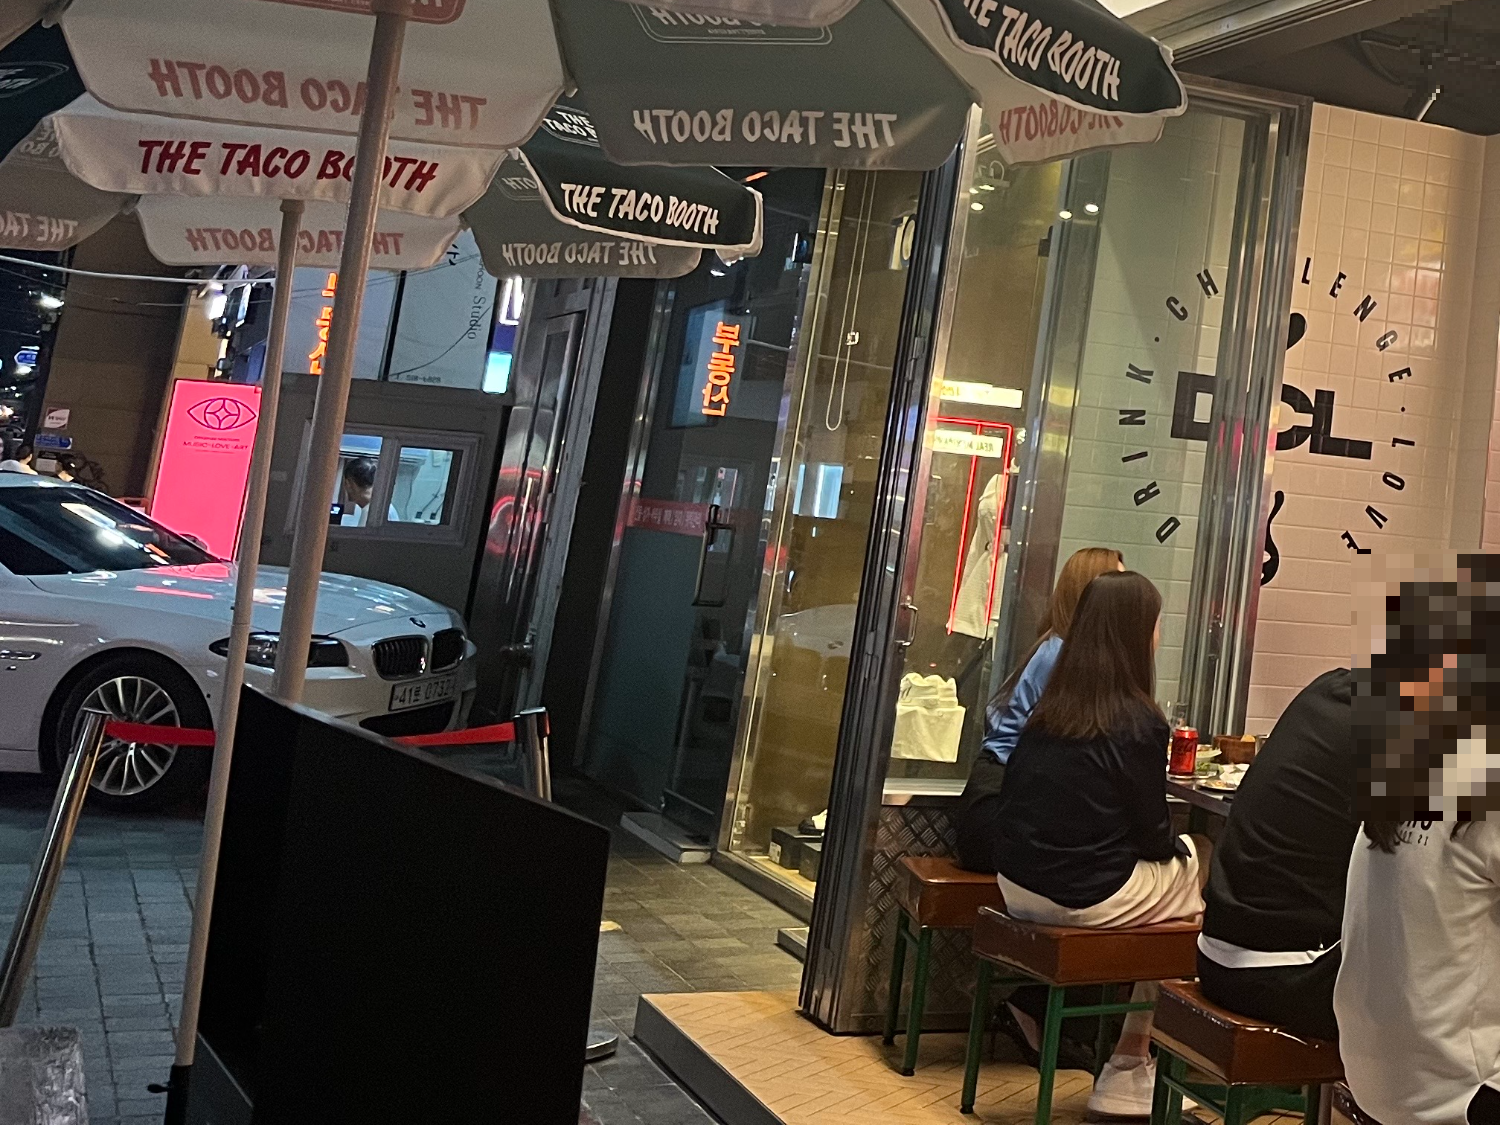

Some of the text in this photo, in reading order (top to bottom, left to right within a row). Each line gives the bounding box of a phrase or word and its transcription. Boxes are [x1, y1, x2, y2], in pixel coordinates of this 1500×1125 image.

[995, 5, 1052, 71] TACO
[1050, 30, 1122, 102] BOOTH
[138, 140, 213, 175] THE
[220, 143, 310, 178] TACO
[560, 183, 720, 235] THE TACO BOOTH
[467, 296, 487, 340] Studio
[1118, 362, 1181, 544] DRINK
